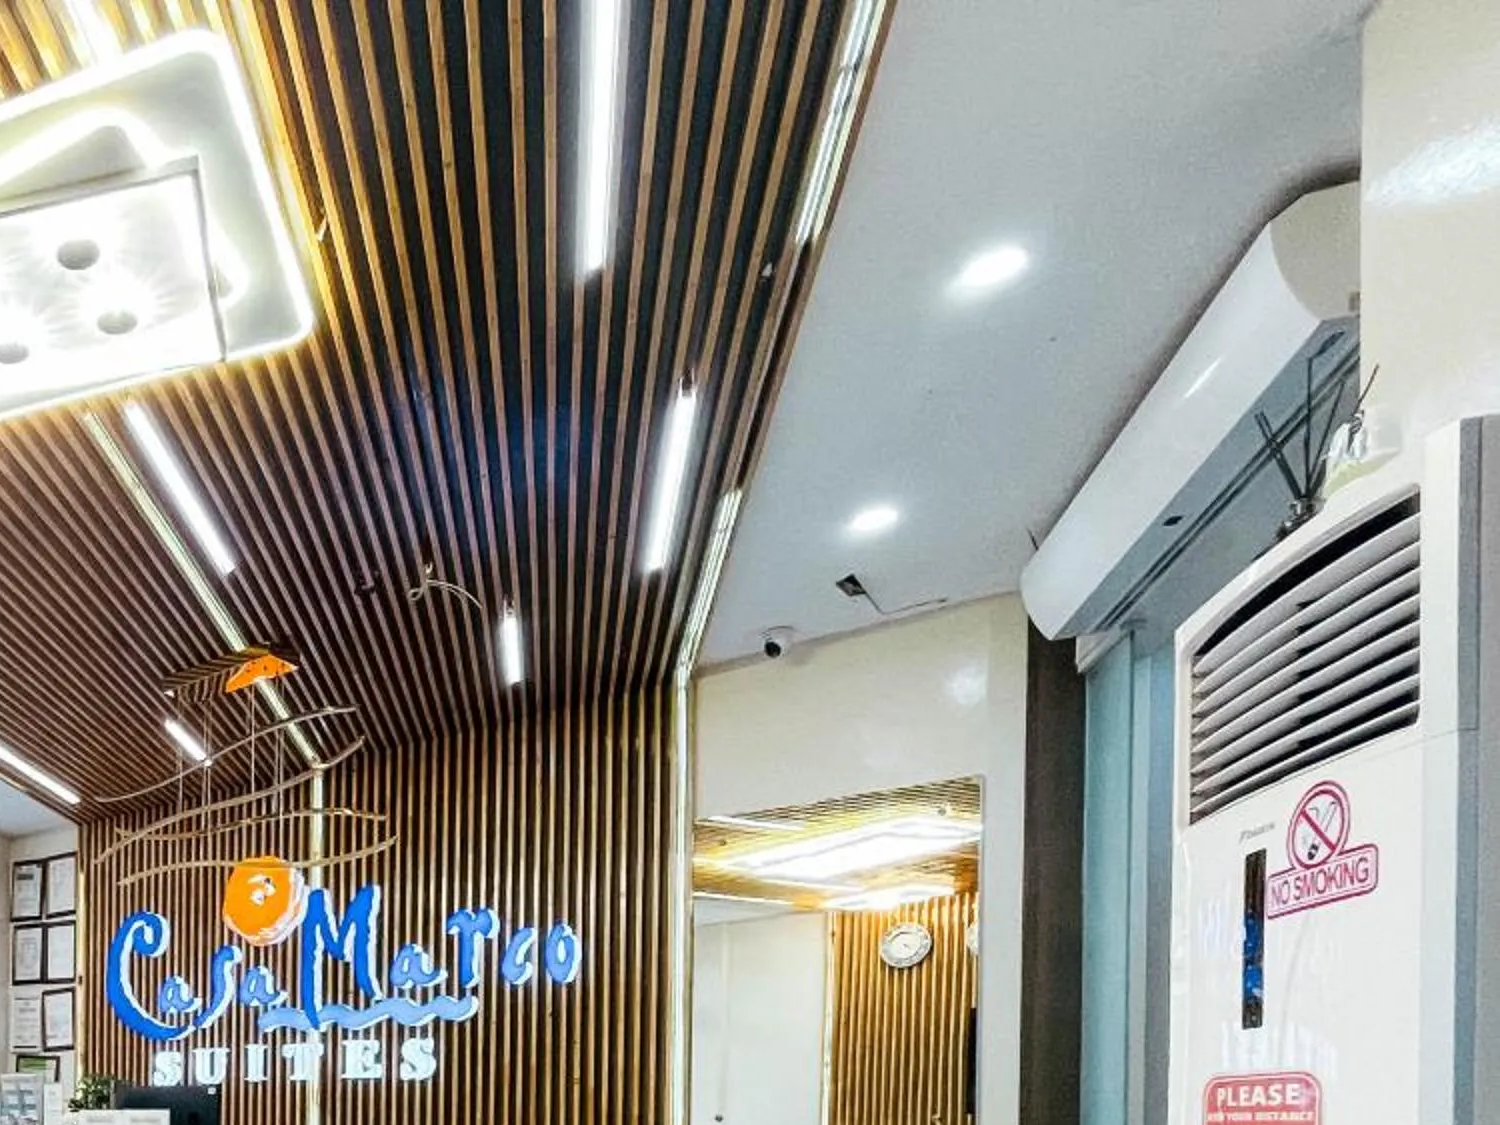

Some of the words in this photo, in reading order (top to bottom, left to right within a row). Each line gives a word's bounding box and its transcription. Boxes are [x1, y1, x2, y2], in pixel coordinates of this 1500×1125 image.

[1270, 879, 1291, 908] NO
[1293, 856, 1369, 900] SMOKING
[152, 1038, 439, 1087] SUITES
[1216, 1083, 1300, 1107] PLEASE
